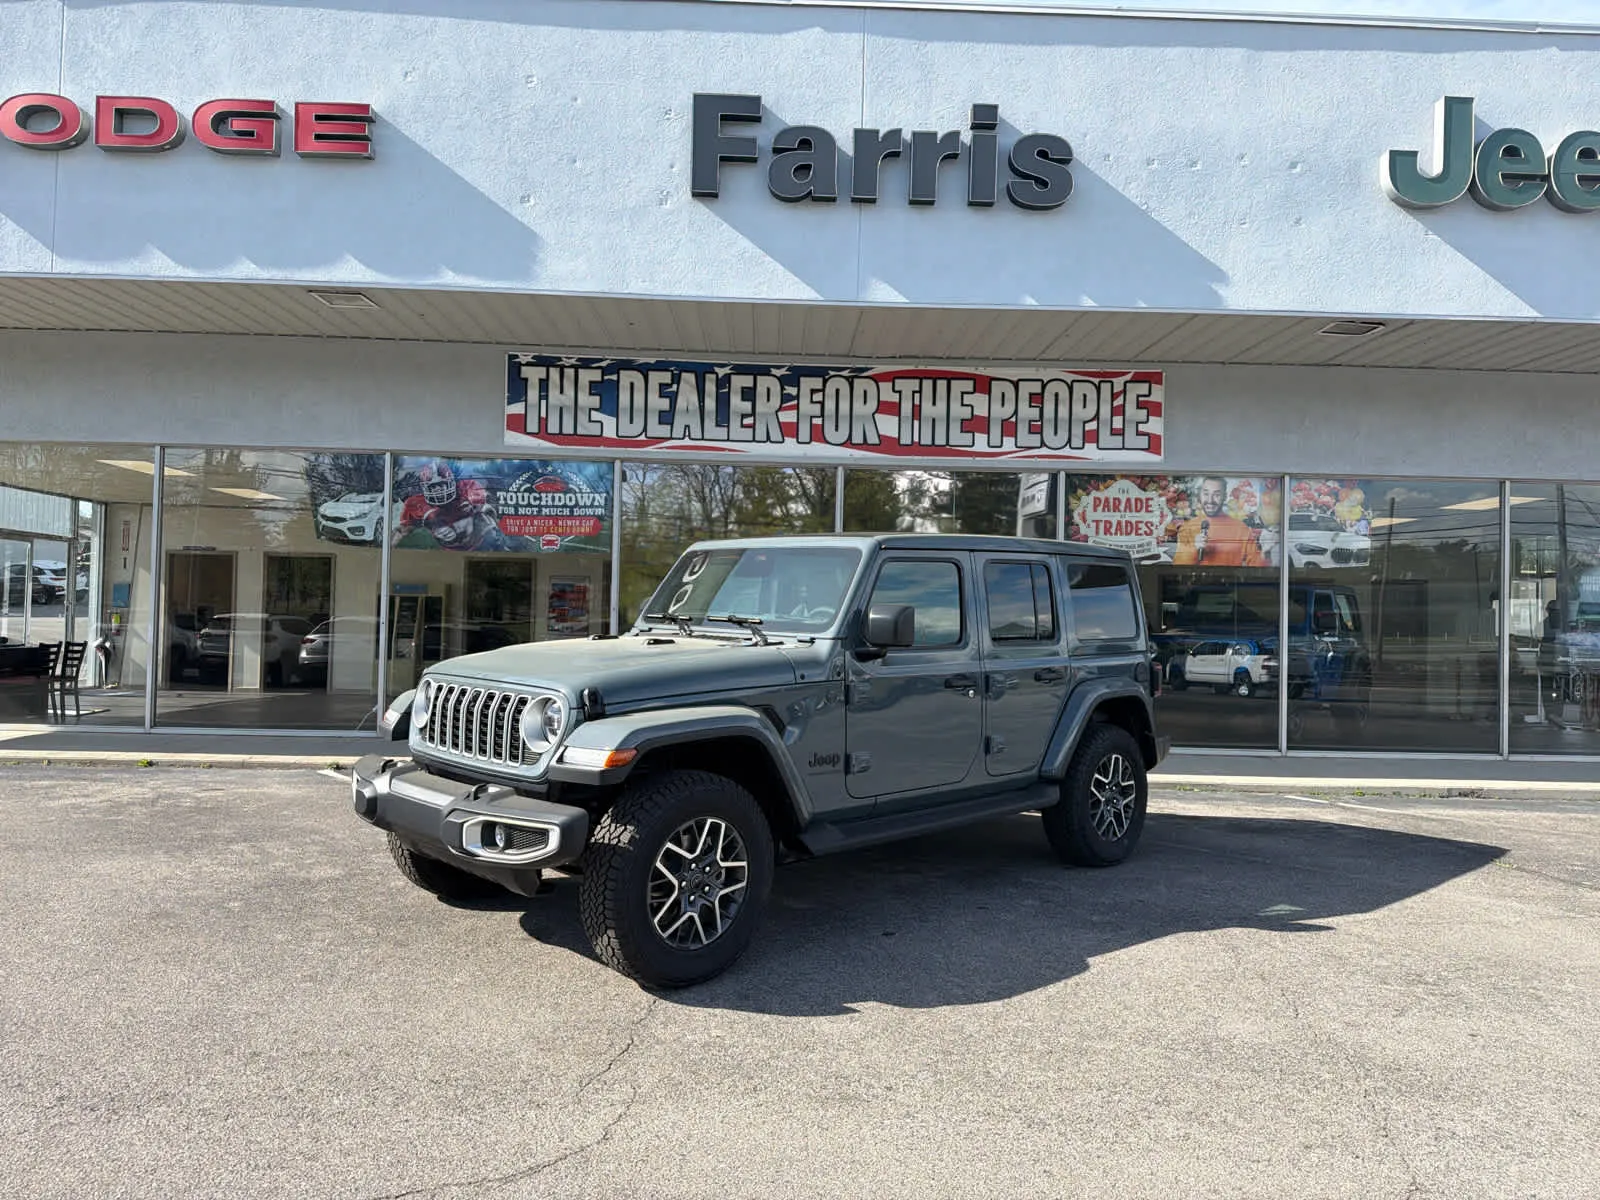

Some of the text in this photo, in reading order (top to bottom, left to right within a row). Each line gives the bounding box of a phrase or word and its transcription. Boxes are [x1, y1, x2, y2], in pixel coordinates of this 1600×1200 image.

[0, 93, 375, 160] ODGE
[691, 93, 1074, 211] Farris
[520, 364, 1152, 450] THE DEALER FOR THE PEOPLE
[497, 492, 606, 506] TOUCHDOWN
[1092, 496, 1154, 513] PARADE
[499, 506, 515, 514] FOR
[542, 508, 570, 516] MUCH
[1092, 520, 1154, 536] TRADES
[808, 752, 841, 768] Jeep
